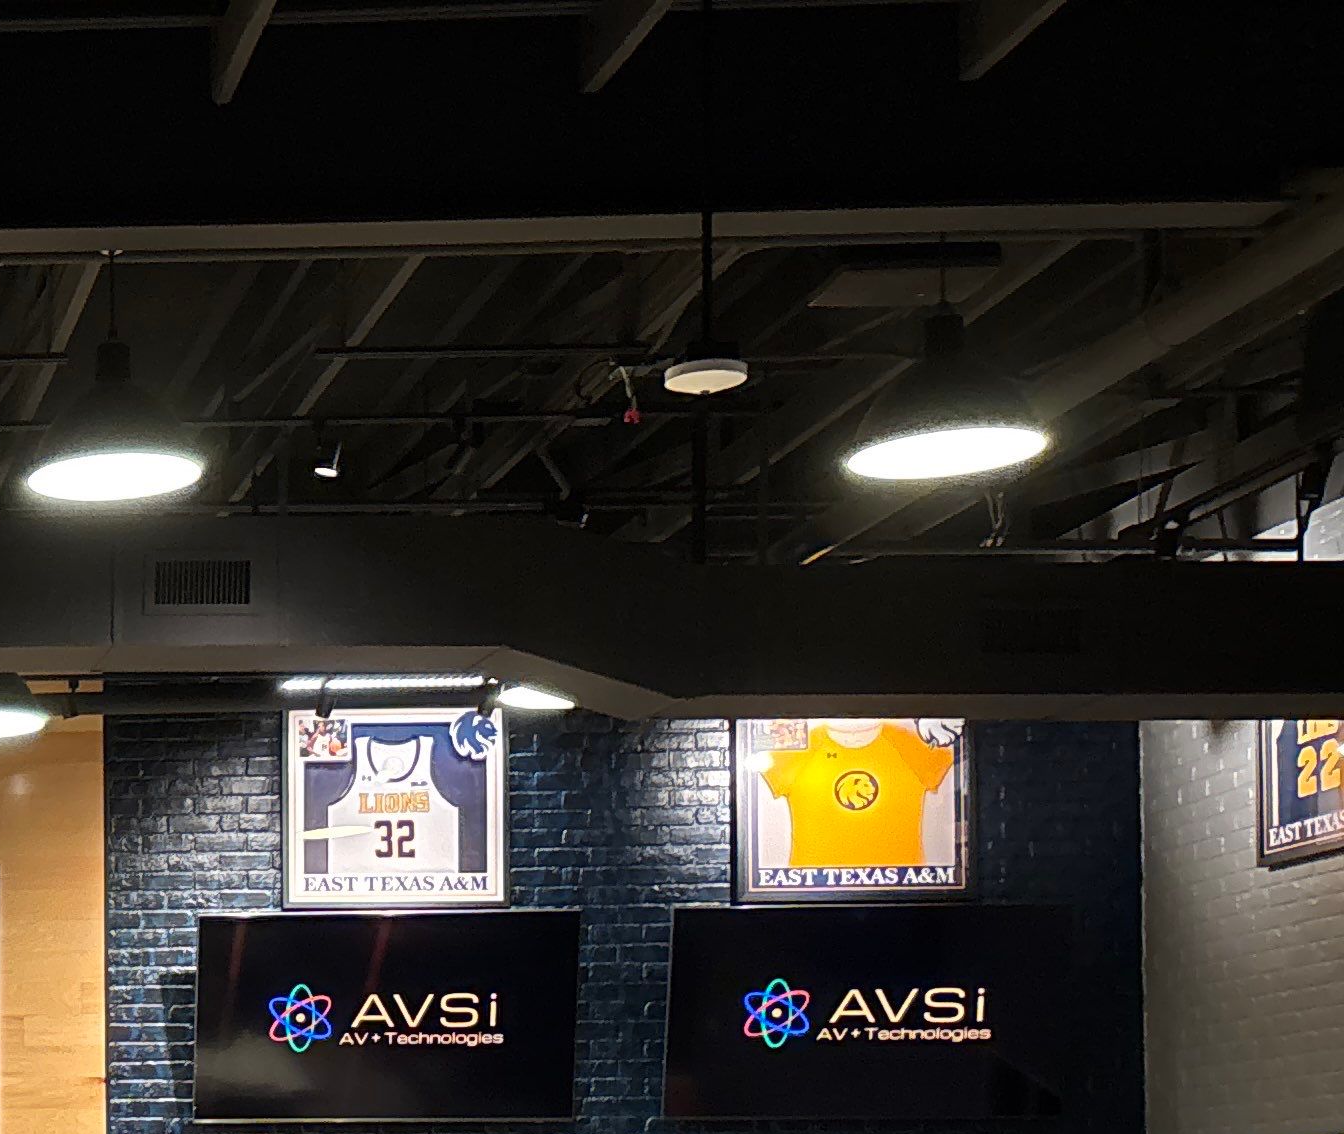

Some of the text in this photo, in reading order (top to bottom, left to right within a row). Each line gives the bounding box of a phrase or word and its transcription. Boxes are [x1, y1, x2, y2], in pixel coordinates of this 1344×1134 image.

[1297, 738, 1341, 798] 22
[358, 791, 430, 814] LIONS
[374, 820, 416, 858] 32
[1269, 820, 1303, 847] EAST
[303, 876, 488, 891] EAST TEXAS A&M
[758, 867, 957, 887] EAST TEXAS A&M
[350, 992, 497, 1028] AVSi
[829, 987, 986, 1023] AVSi
